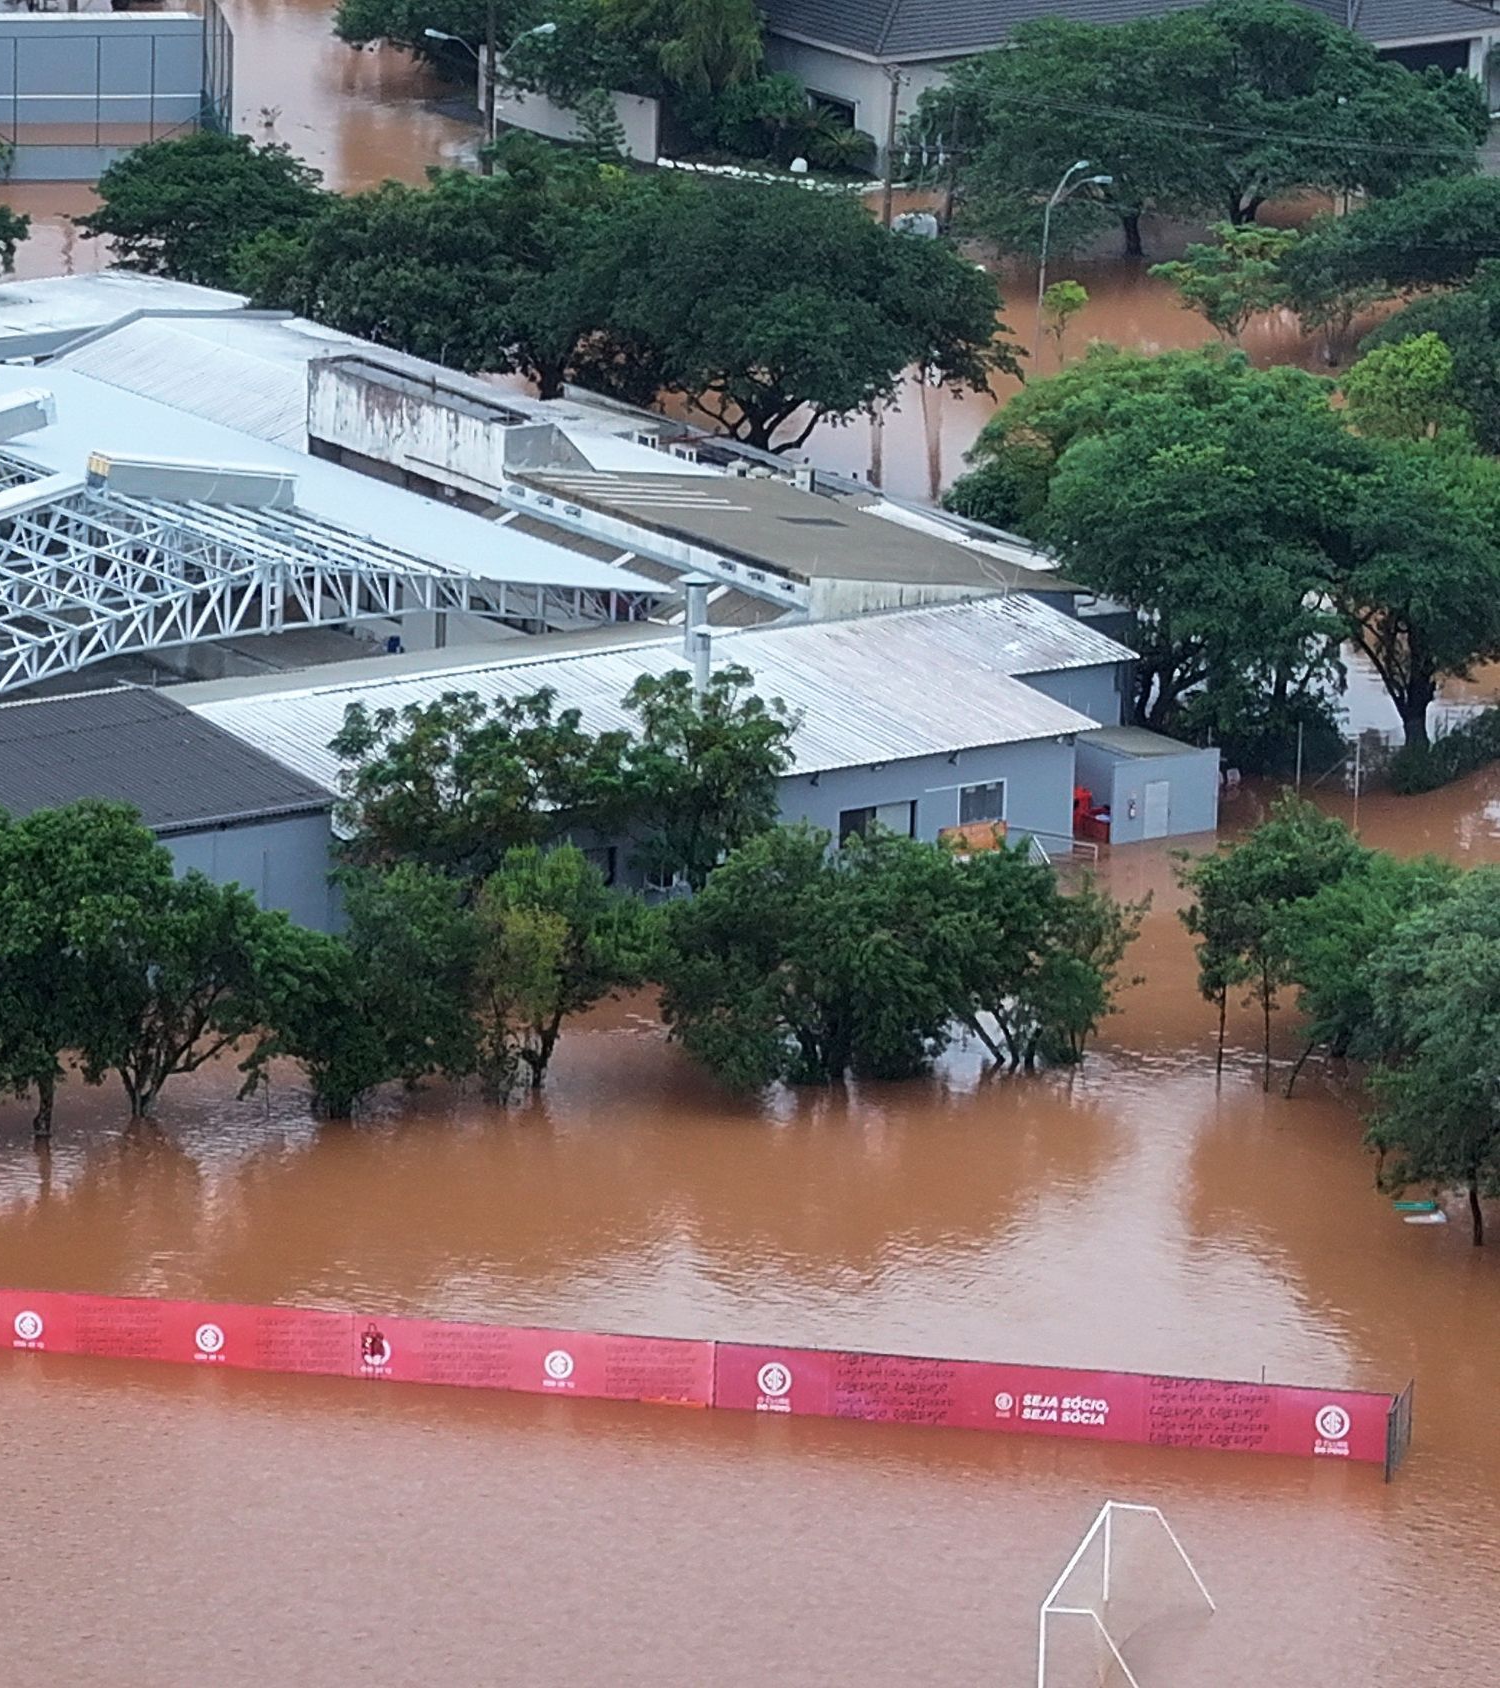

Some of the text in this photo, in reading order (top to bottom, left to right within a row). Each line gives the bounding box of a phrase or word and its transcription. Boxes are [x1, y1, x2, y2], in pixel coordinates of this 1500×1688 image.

[1022, 1394, 1109, 1413] SEJA SÓCIO,
[1021, 1407, 1057, 1422] SEJA
[1061, 1409, 1105, 1425] SÓCIA
